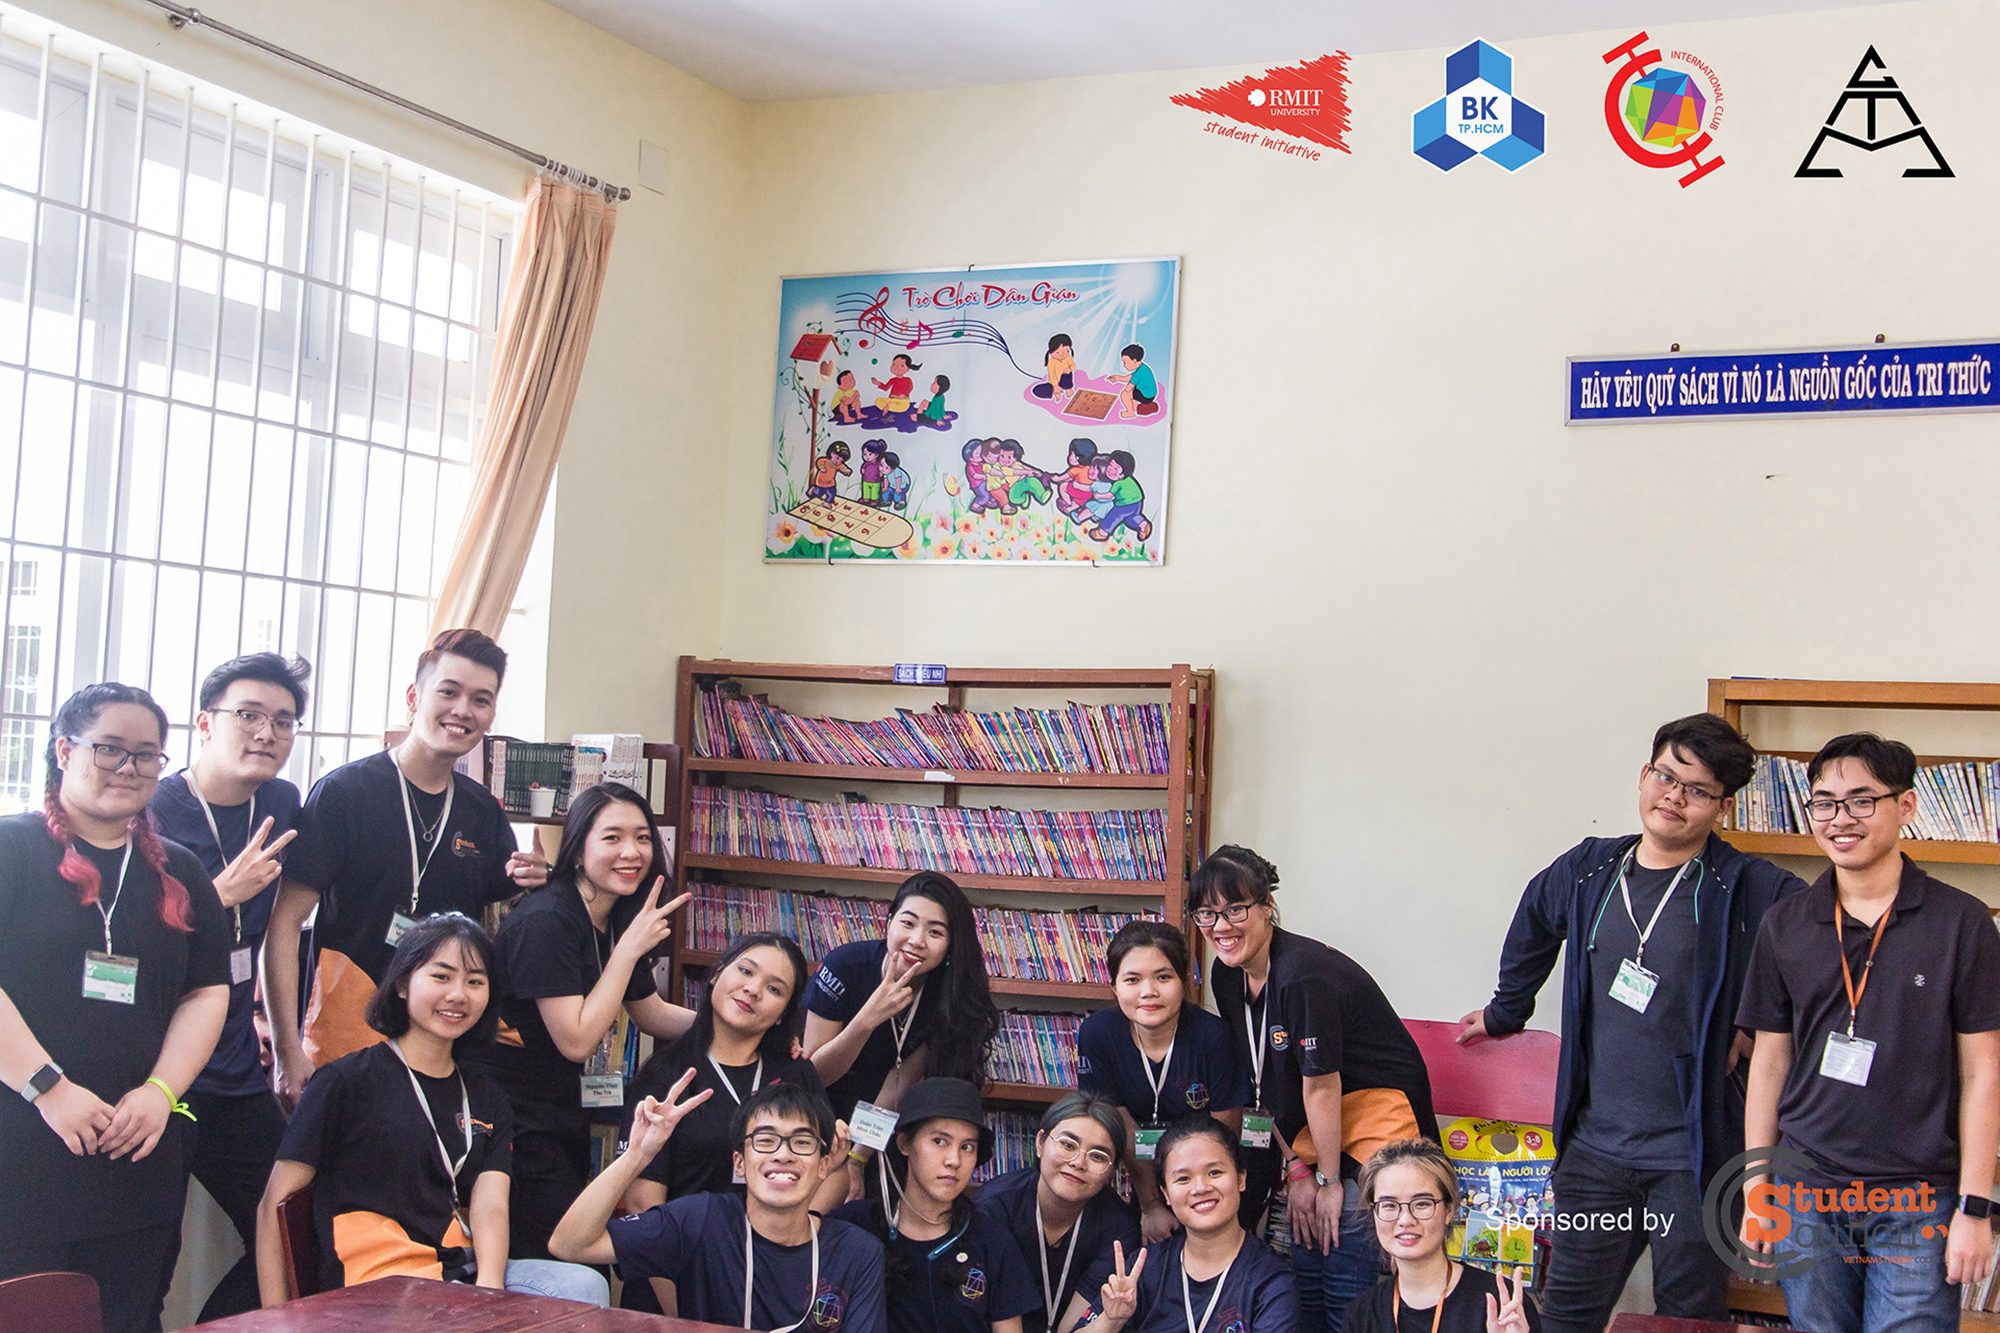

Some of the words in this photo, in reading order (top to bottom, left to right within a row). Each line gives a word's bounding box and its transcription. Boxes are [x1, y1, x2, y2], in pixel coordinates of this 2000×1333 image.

[902, 287, 932, 308] Trò
[982, 284, 1026, 306] Dân
[1031, 281, 1078, 304] Gian
[1580, 370, 1611, 409] HÃY
[1614, 368, 1643, 408] YÊU
[1646, 366, 1676, 415] QUÝ
[1679, 365, 1719, 407] SÁCH
[1722, 364, 1738, 404] VÌ
[1741, 363, 1762, 404] NÓ
[1765, 361, 1786, 403] LÀ
[1789, 353, 1841, 402] NGUỒN
[1844, 353, 1877, 400] GỐC
[1880, 354, 1913, 398] CỦA
[1916, 362, 1944, 397] TRI
[1947, 353, 1991, 396] THỨC
